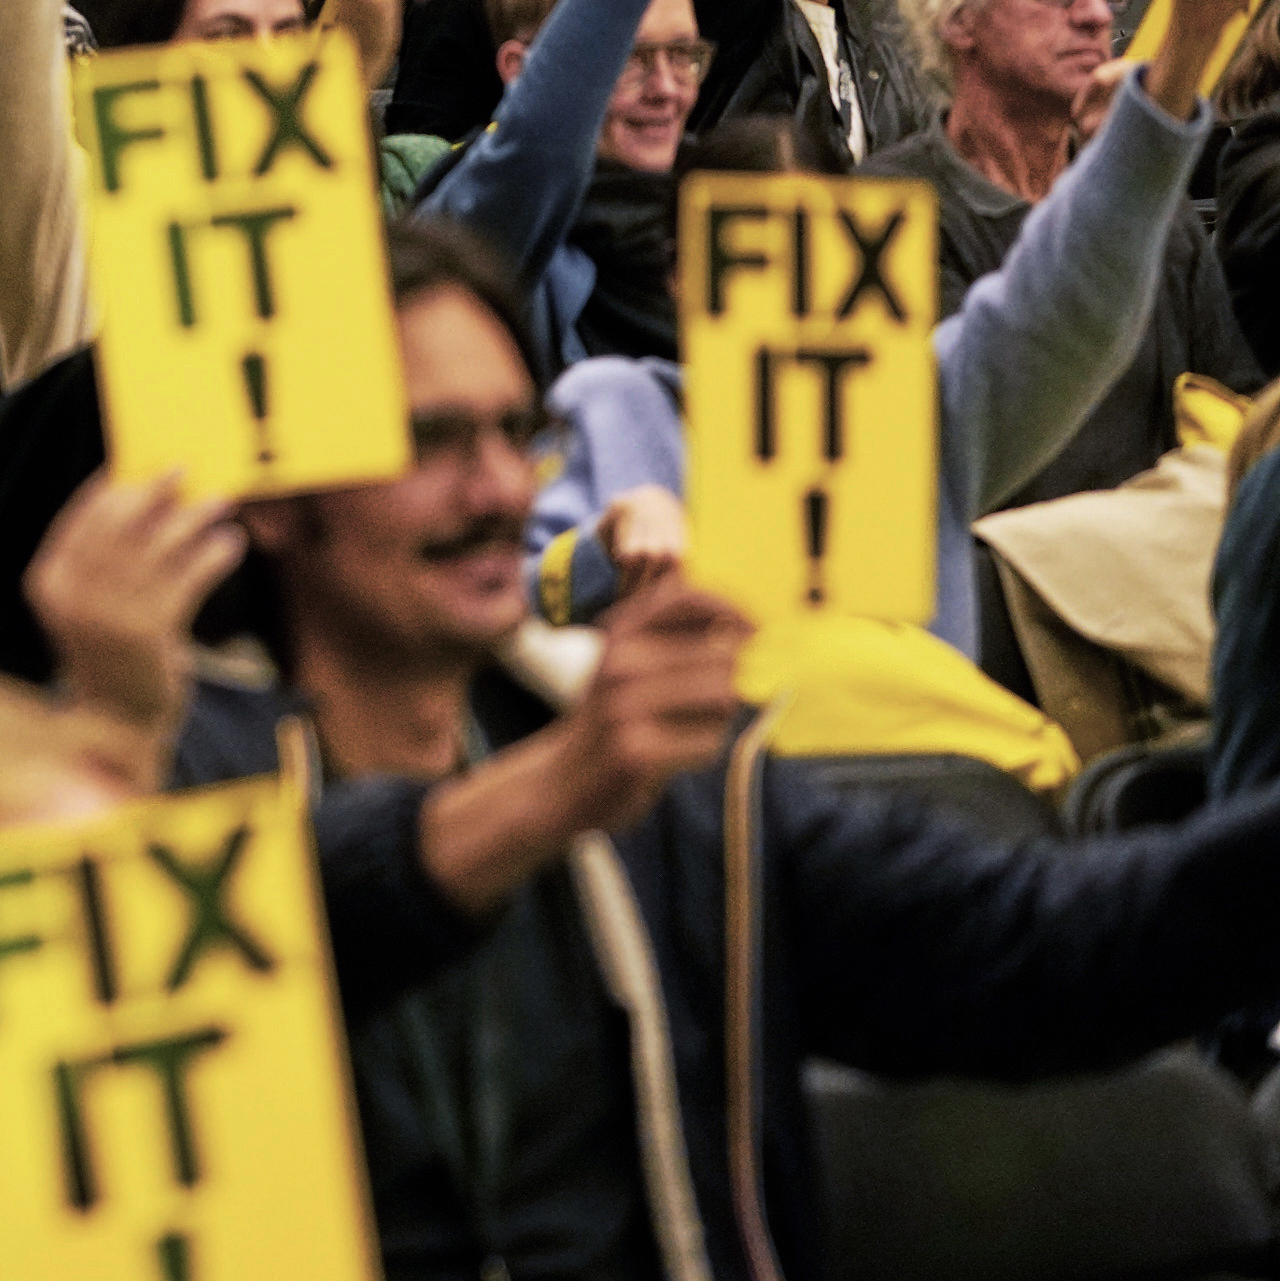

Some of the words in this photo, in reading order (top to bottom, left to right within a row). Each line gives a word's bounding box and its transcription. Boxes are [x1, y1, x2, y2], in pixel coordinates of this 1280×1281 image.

[94, 62, 334, 192] FIX
[170, 205, 297, 328] IT
[707, 203, 906, 322] FIX
[238, 353, 277, 462] !
[754, 347, 869, 460] IT
[803, 489, 828, 604] !
[56, 1028, 226, 1212] IT
